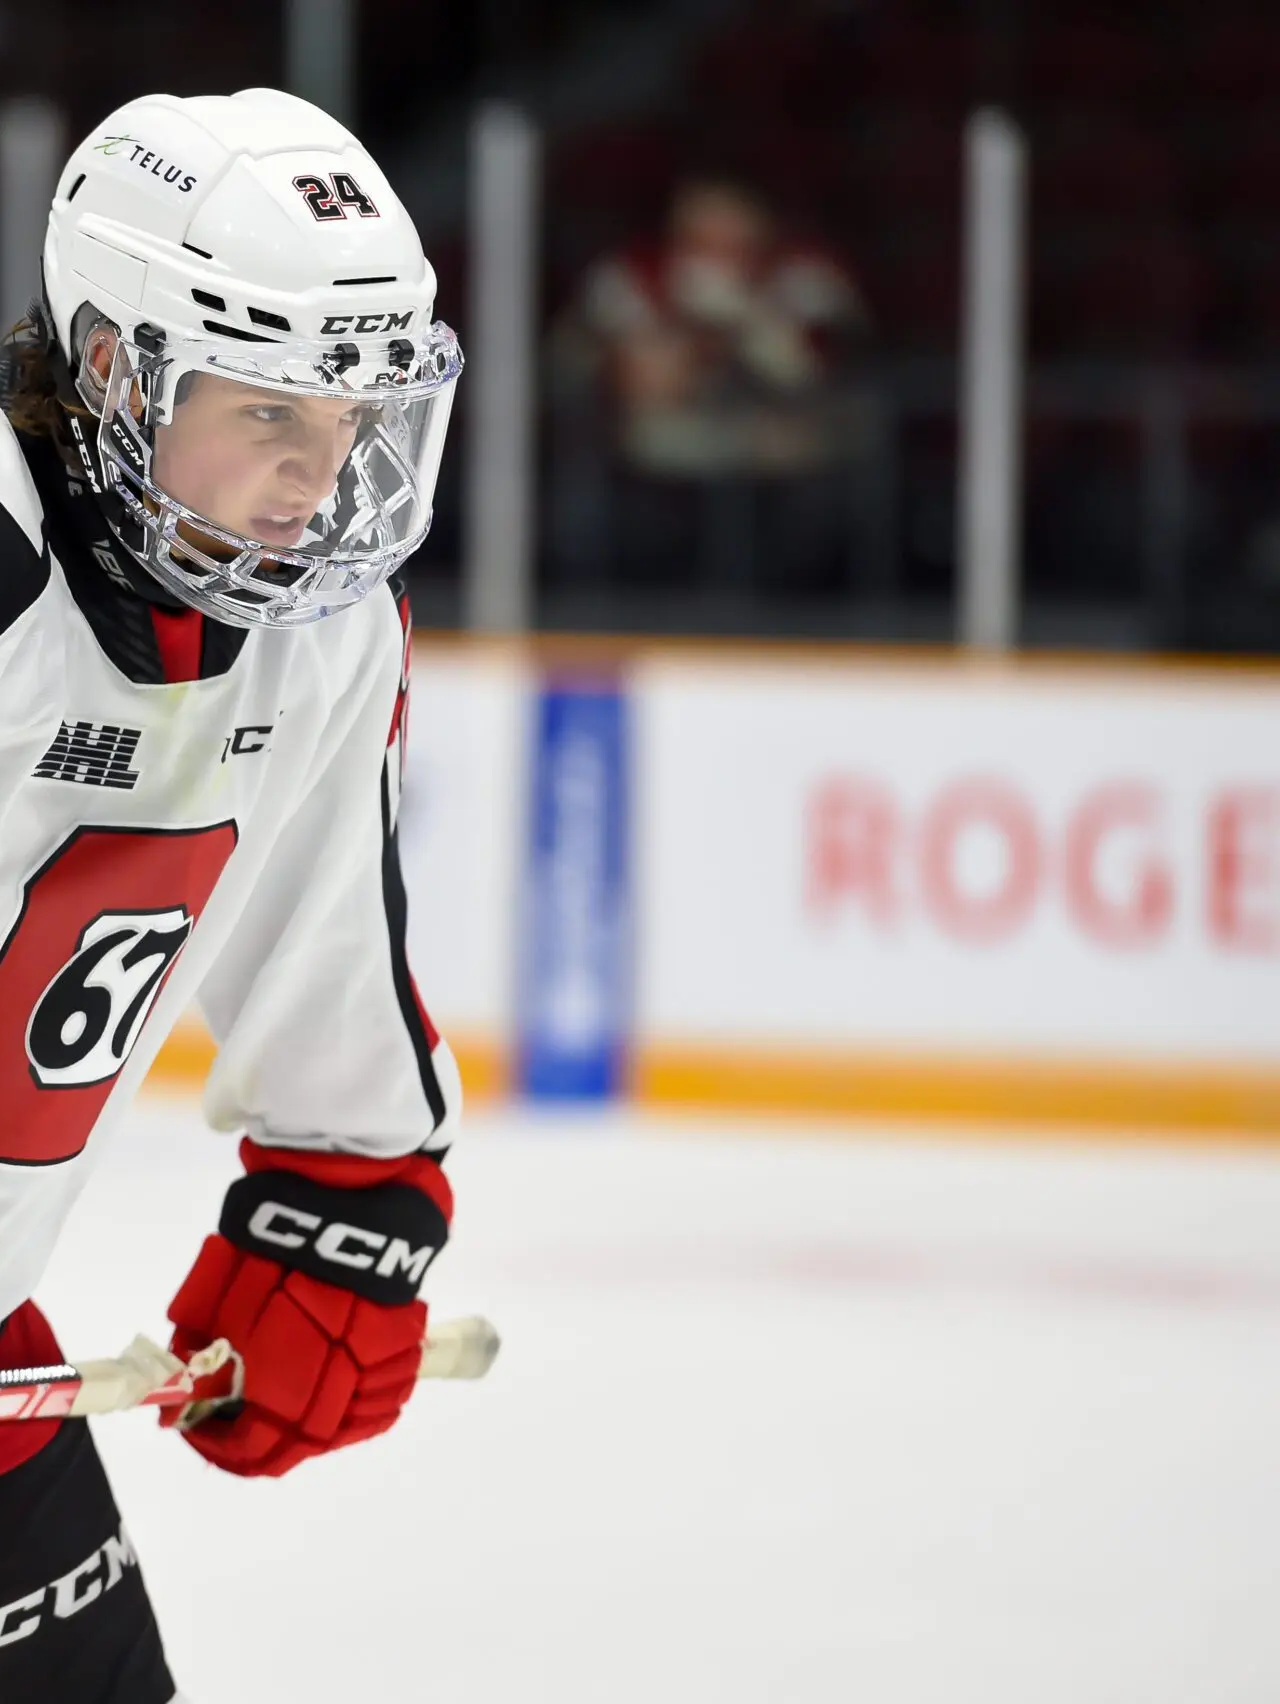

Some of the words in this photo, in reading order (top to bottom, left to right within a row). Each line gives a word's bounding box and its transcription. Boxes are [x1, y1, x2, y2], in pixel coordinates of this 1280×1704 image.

[129, 144, 198, 192] TELUS
[291, 173, 380, 221] 24
[320, 311, 414, 334] CCM
[70, 416, 102, 493] CCM
[112, 422, 144, 466] CCM
[25, 916, 193, 1069] 67
[248, 1201, 434, 1284] CCM
